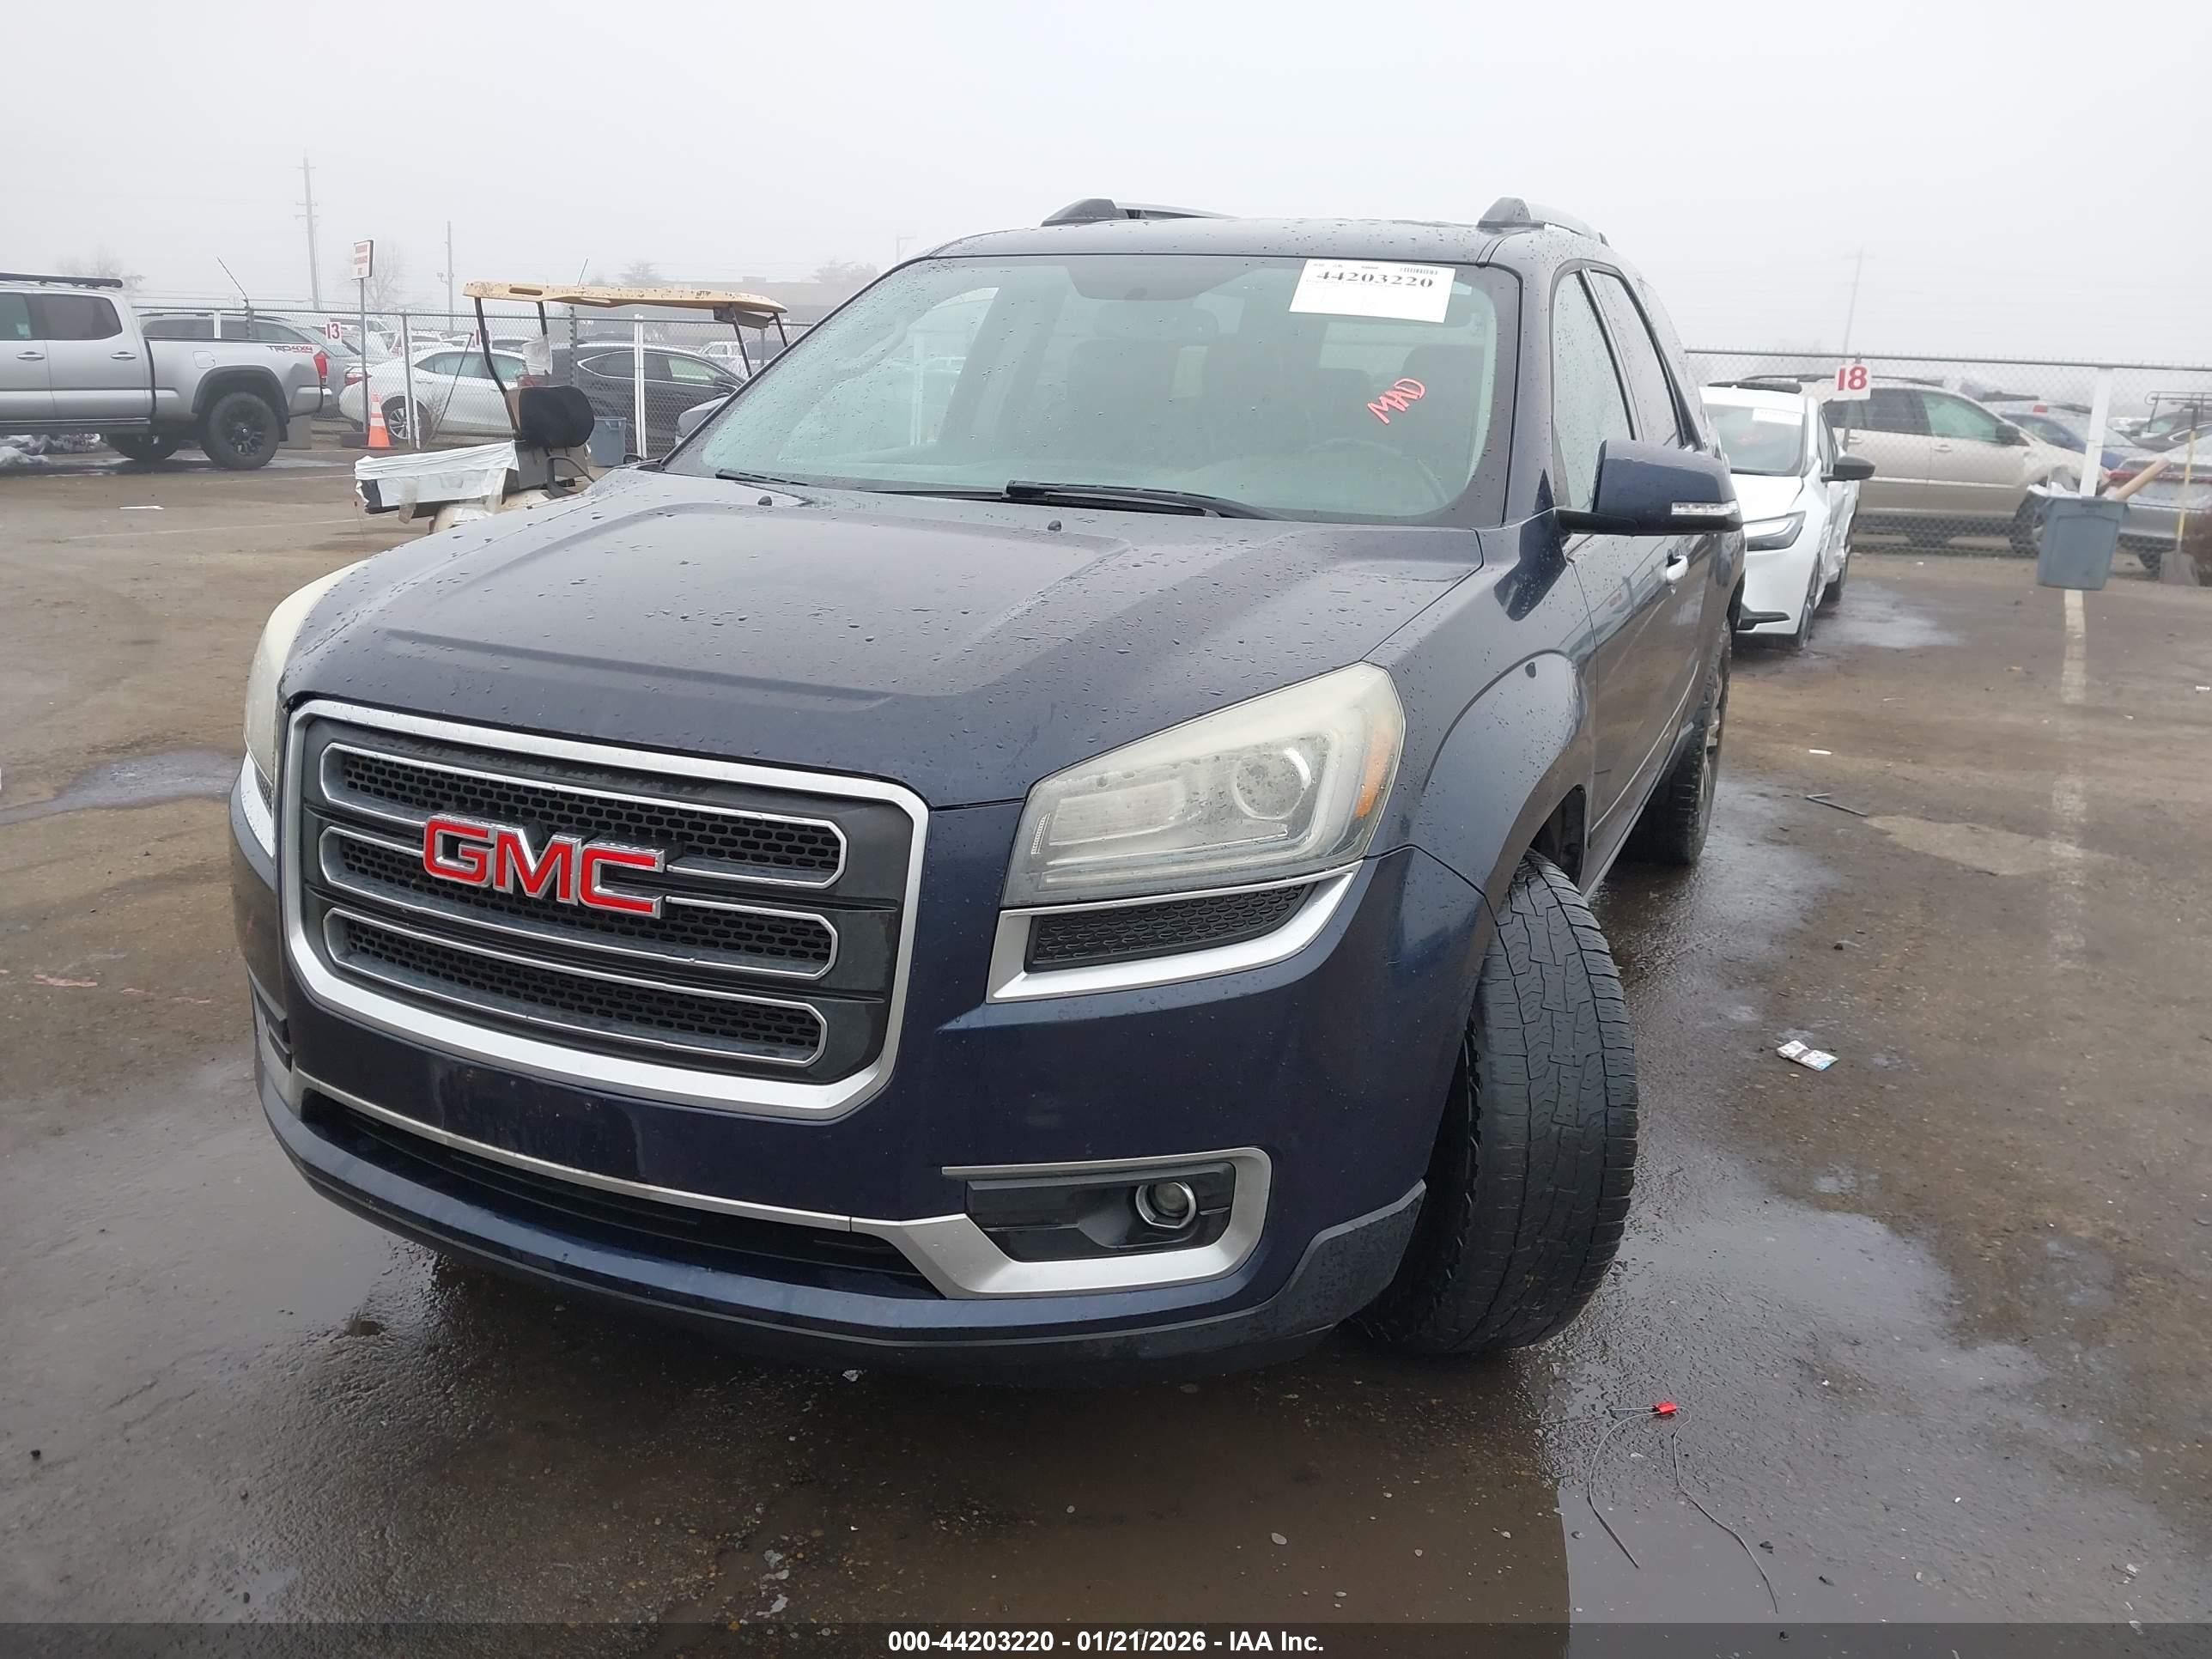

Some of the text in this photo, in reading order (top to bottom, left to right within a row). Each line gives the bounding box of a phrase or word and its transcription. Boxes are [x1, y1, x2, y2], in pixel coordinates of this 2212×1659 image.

[1316, 271, 1433, 288] 44203220
[326, 323, 340, 339] 13
[1838, 366, 1868, 391] 18
[422, 815, 665, 920] GMC
